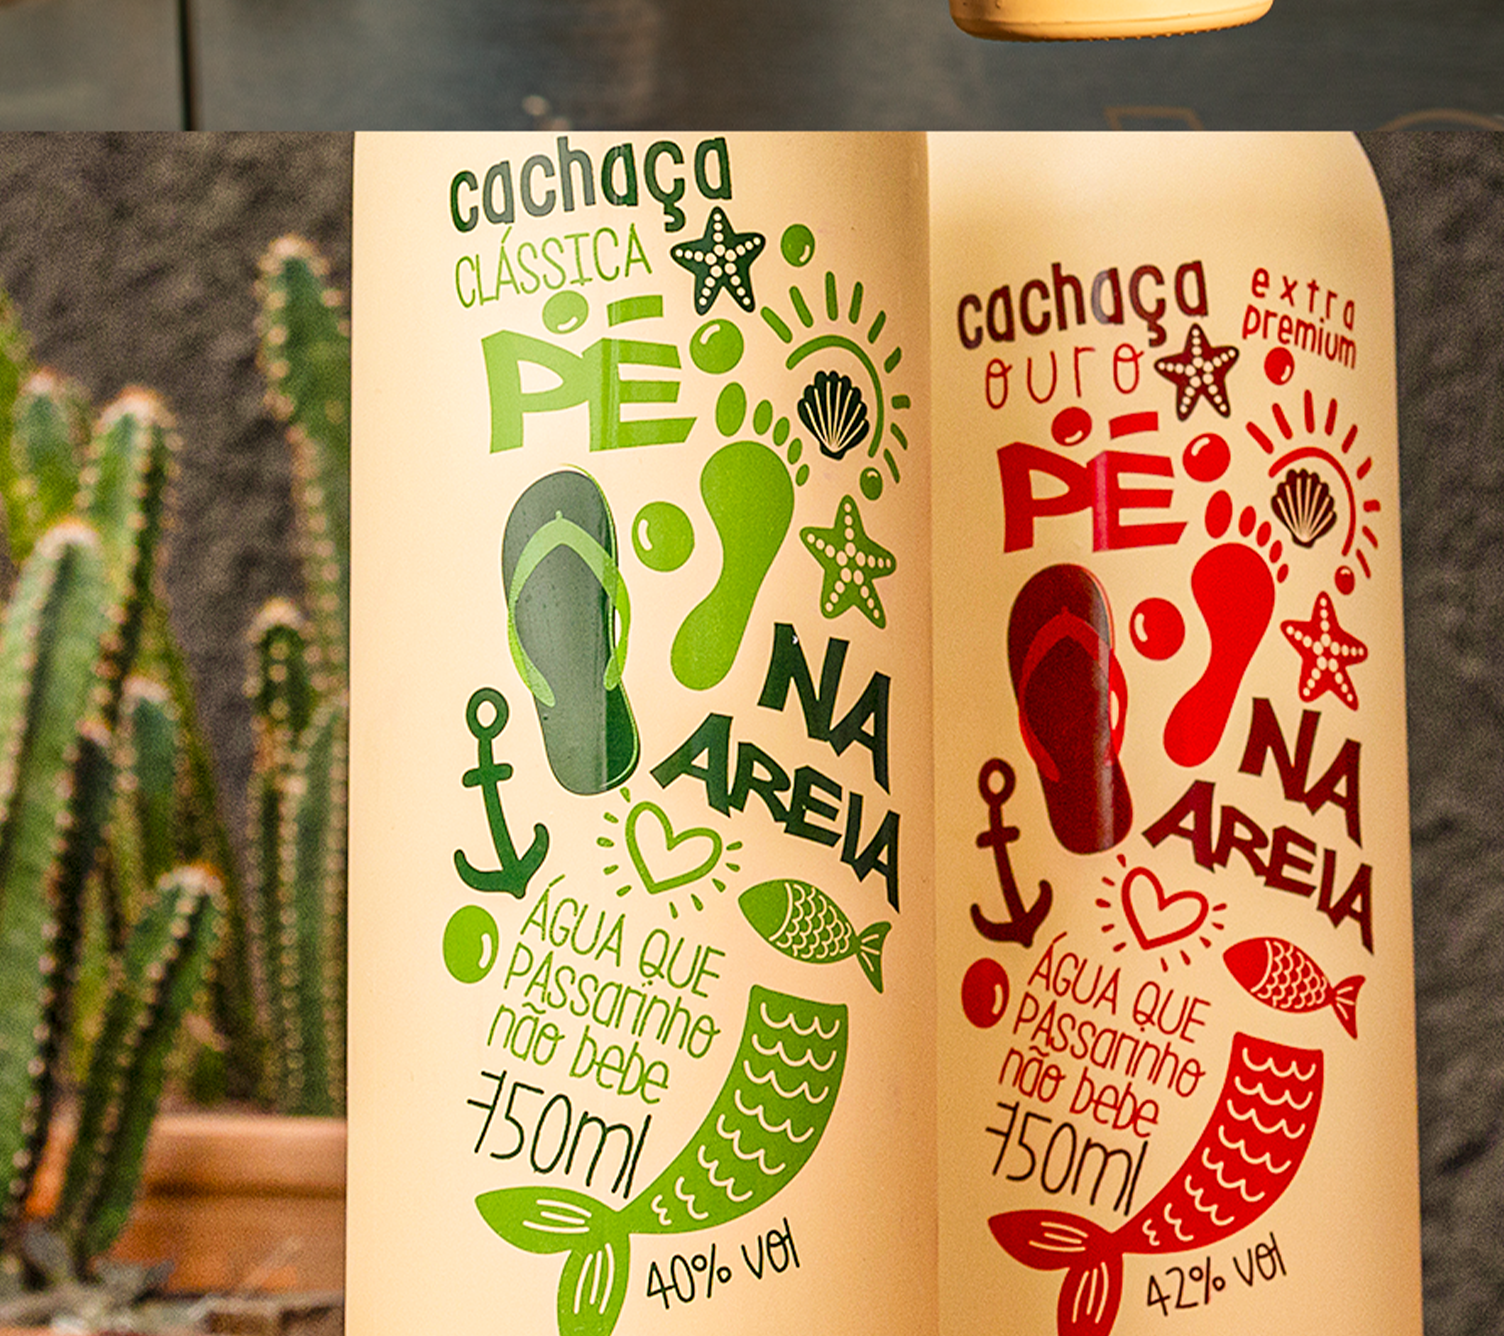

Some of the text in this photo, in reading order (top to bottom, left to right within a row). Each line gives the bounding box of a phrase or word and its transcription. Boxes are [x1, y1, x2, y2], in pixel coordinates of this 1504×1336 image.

[449, 135, 734, 233] cachaça
[454, 222, 653, 309] CLÁSSICA
[957, 260, 1209, 350] cachaça
[1251, 267, 1356, 332] extra
[481, 294, 698, 454] PÉ
[985, 343, 1144, 410] ouro
[1242, 304, 1357, 370] premium
[996, 411, 1189, 553] PÉ
[757, 622, 891, 795] NA
[650, 712, 901, 914] AREIA
[1238, 697, 1363, 850] NA
[1141, 779, 1375, 956] AREIA
[520, 873, 726, 998] ÁGUA QUE
[1027, 931, 1212, 1043] ÁGUA QUE
[486, 1002, 670, 1104] não bebe
[998, 1045, 1160, 1138] não bebe
[467, 1069, 653, 1199] 750ml
[985, 1101, 1149, 1216] 750ml
[646, 1216, 801, 1310] 40% vol
[1146, 1232, 1288, 1317] 42% vol
